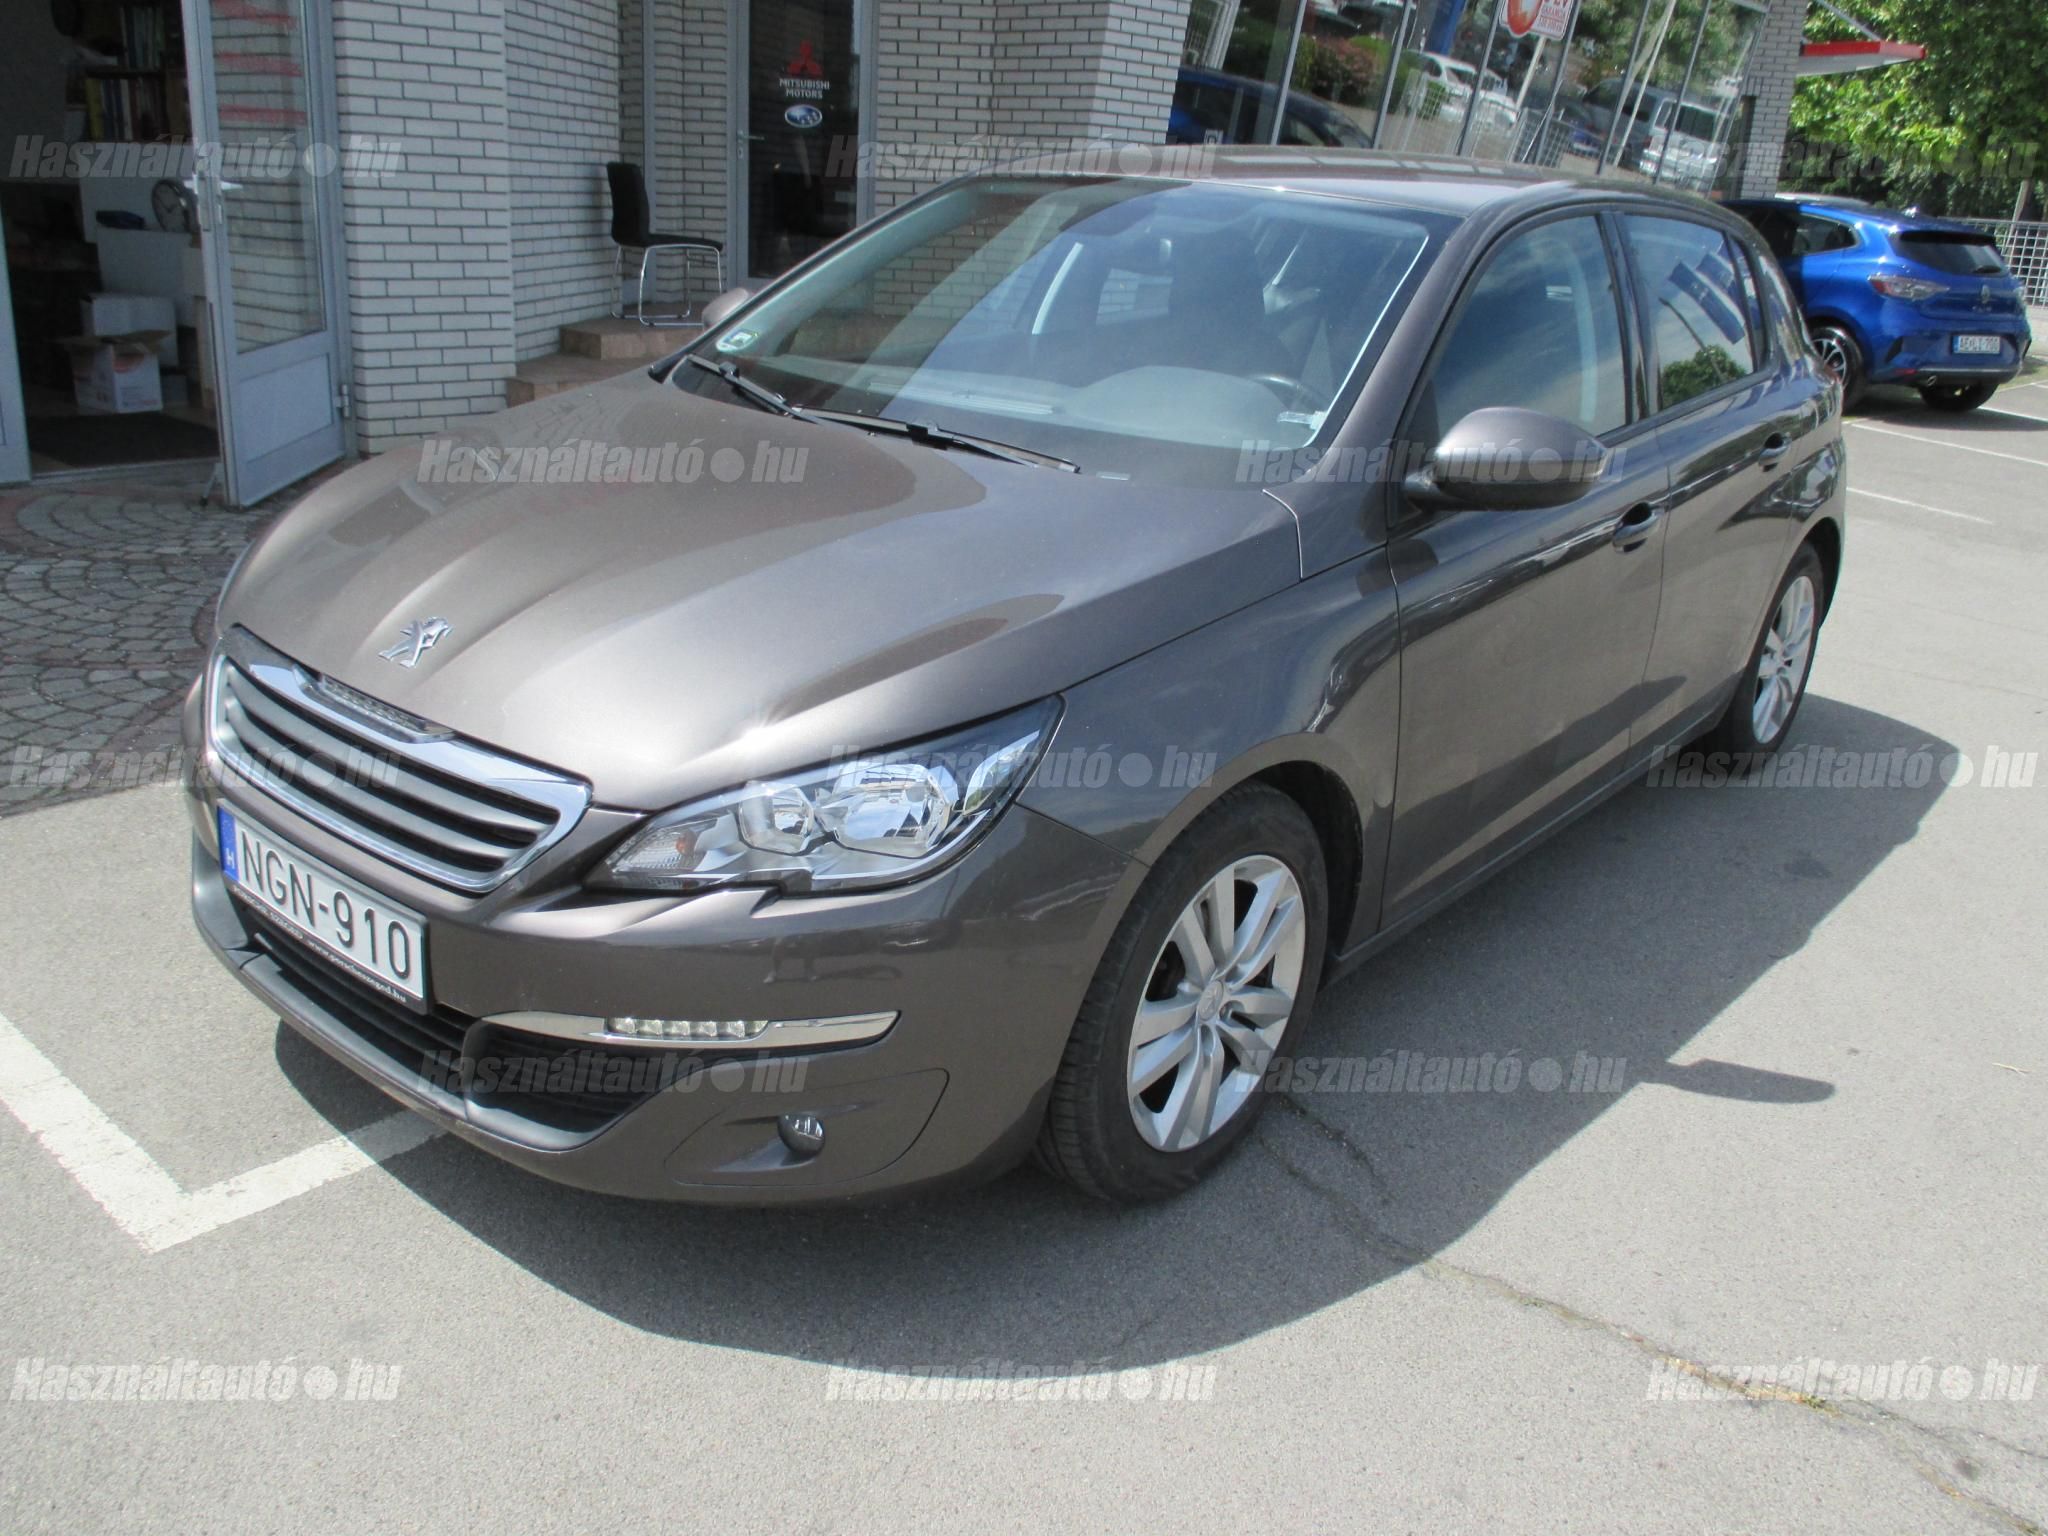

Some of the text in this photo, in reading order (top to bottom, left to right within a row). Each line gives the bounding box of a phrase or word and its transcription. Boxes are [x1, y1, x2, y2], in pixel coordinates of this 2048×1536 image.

[779, 78, 830, 90] MITSUBISHI
[786, 89, 823, 99] MOTORS
[241, 829, 411, 981] NGN-910
